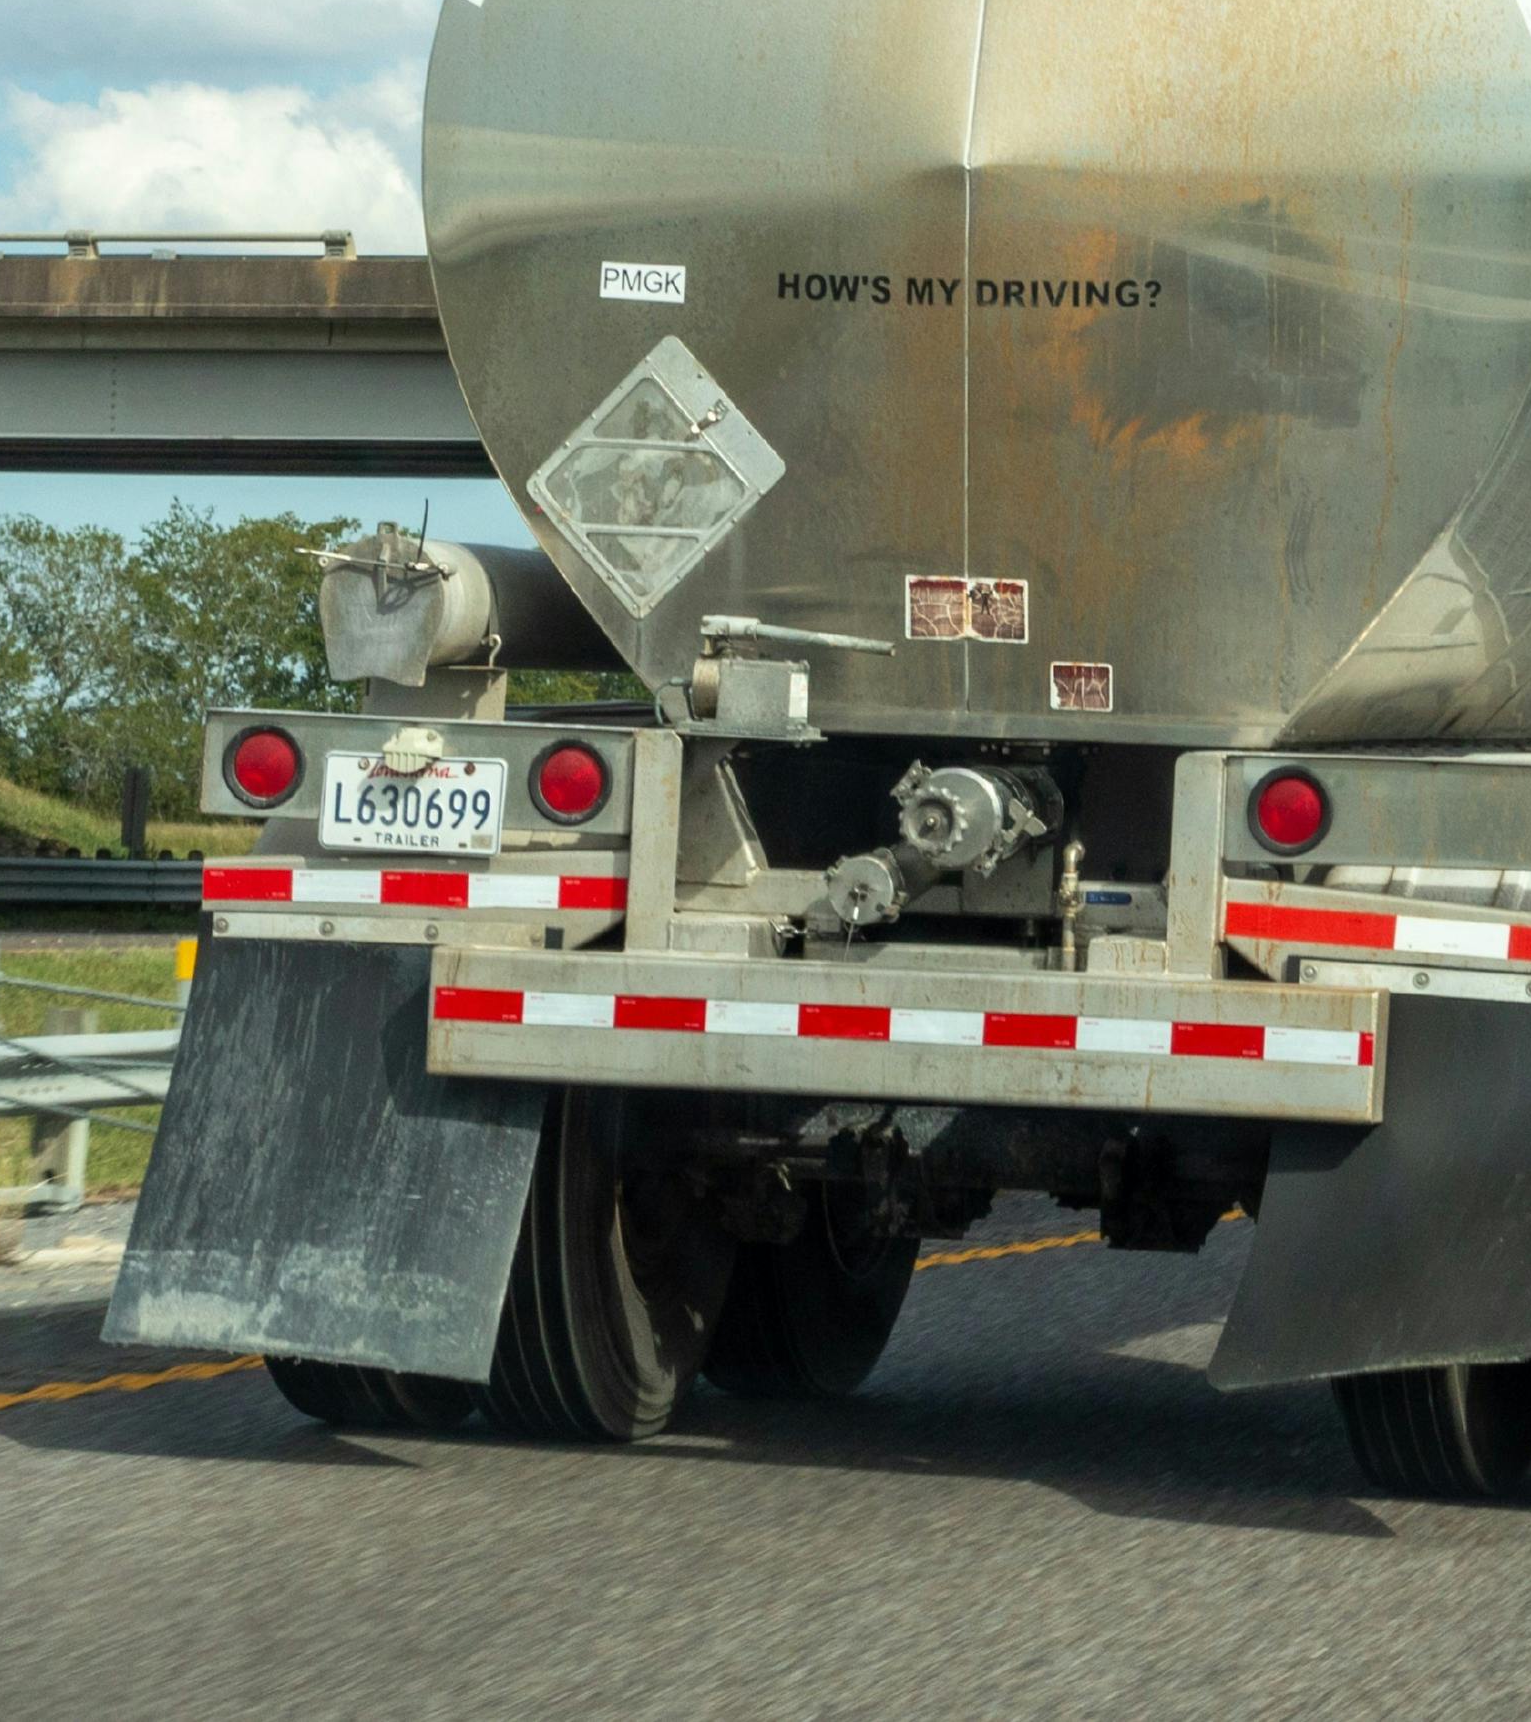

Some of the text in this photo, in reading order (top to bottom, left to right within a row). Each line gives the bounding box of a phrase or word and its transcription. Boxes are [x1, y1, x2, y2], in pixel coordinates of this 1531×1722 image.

[603, 268, 682, 296] PMGK
[777, 272, 1162, 308] HOW'S MY DRIVING?
[334, 781, 491, 830] L630699
[374, 832, 440, 848] TRAILER
